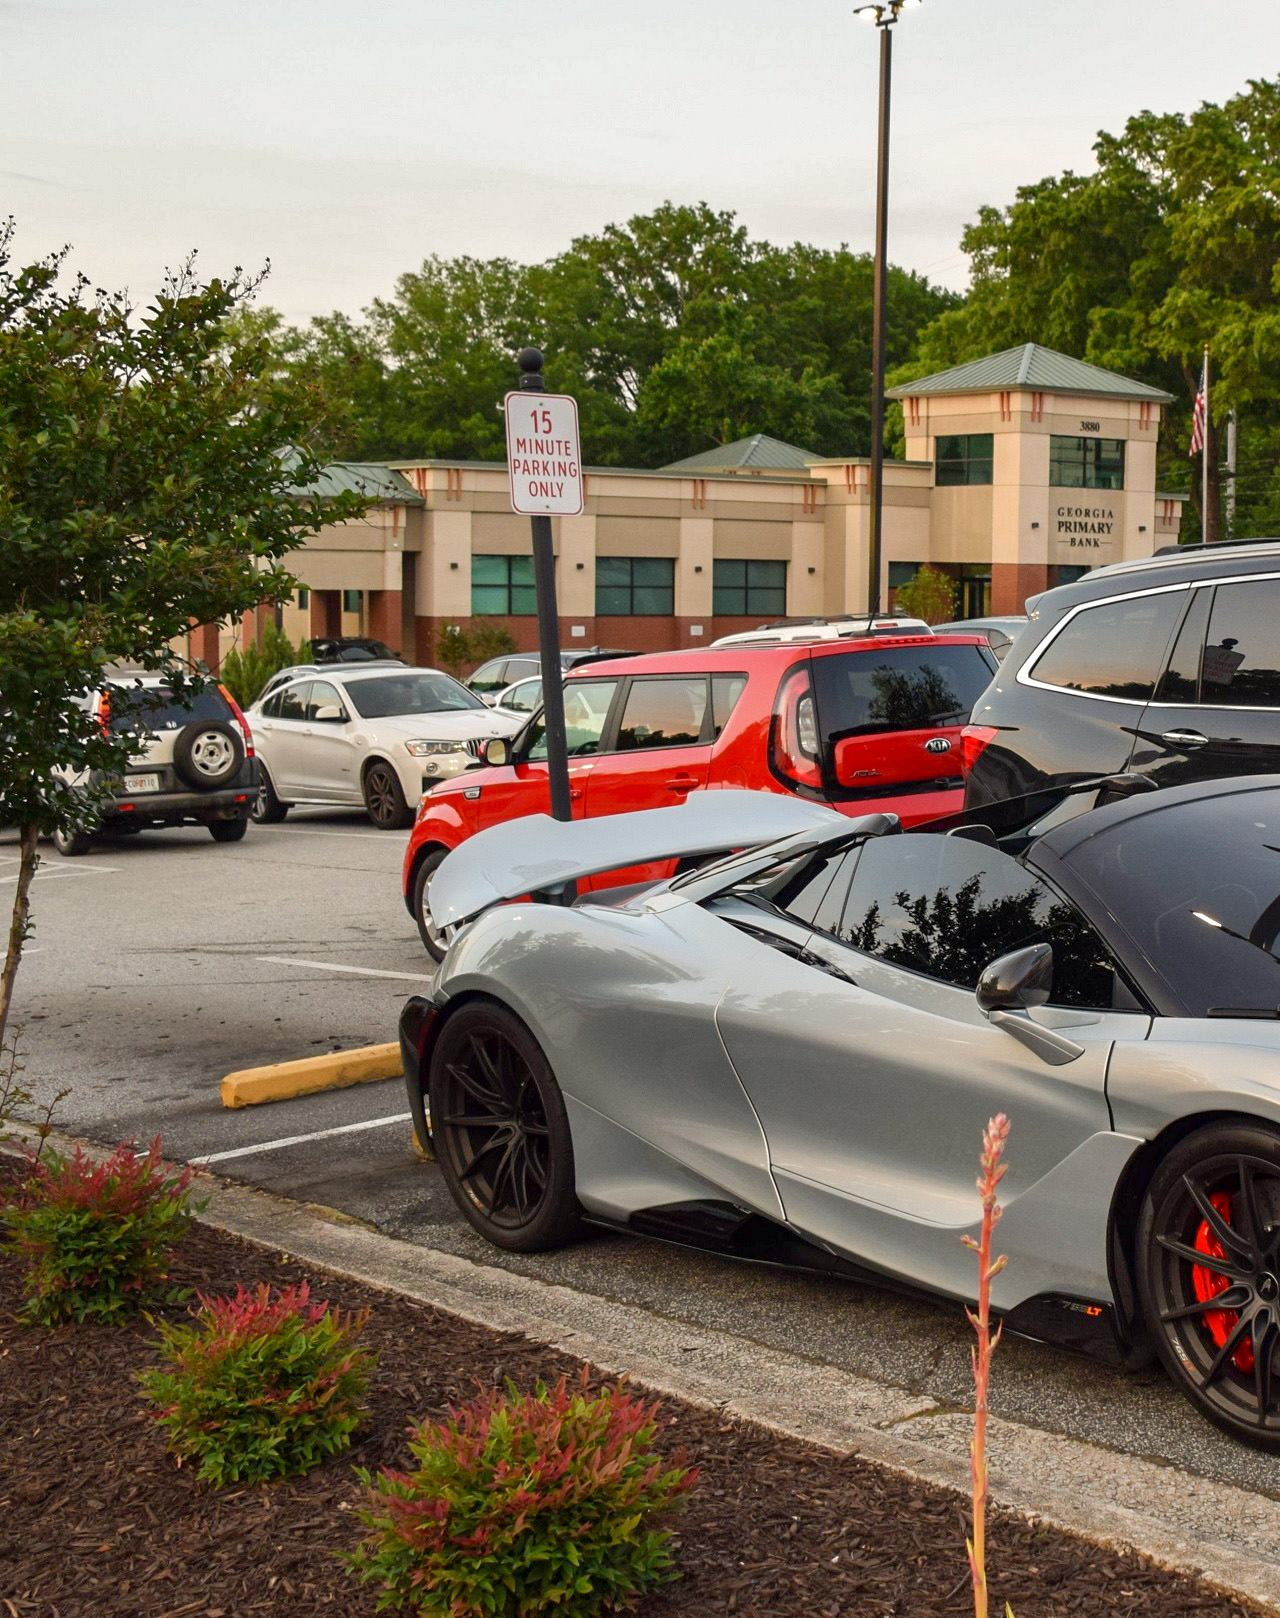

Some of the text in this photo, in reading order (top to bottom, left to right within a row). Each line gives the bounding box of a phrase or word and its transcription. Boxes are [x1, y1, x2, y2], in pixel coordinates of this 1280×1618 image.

[530, 409, 553, 435] 15
[1079, 421, 1101, 432] 3880
[516, 438, 572, 457] MINUTE
[513, 458, 578, 478] PARKING
[528, 480, 564, 498] ONLY
[1057, 507, 1114, 519] GEORGIA
[1057, 520, 1114, 534] PRIMARY
[1070, 538, 1100, 548] BANK
[930, 740, 949, 752] KIA
